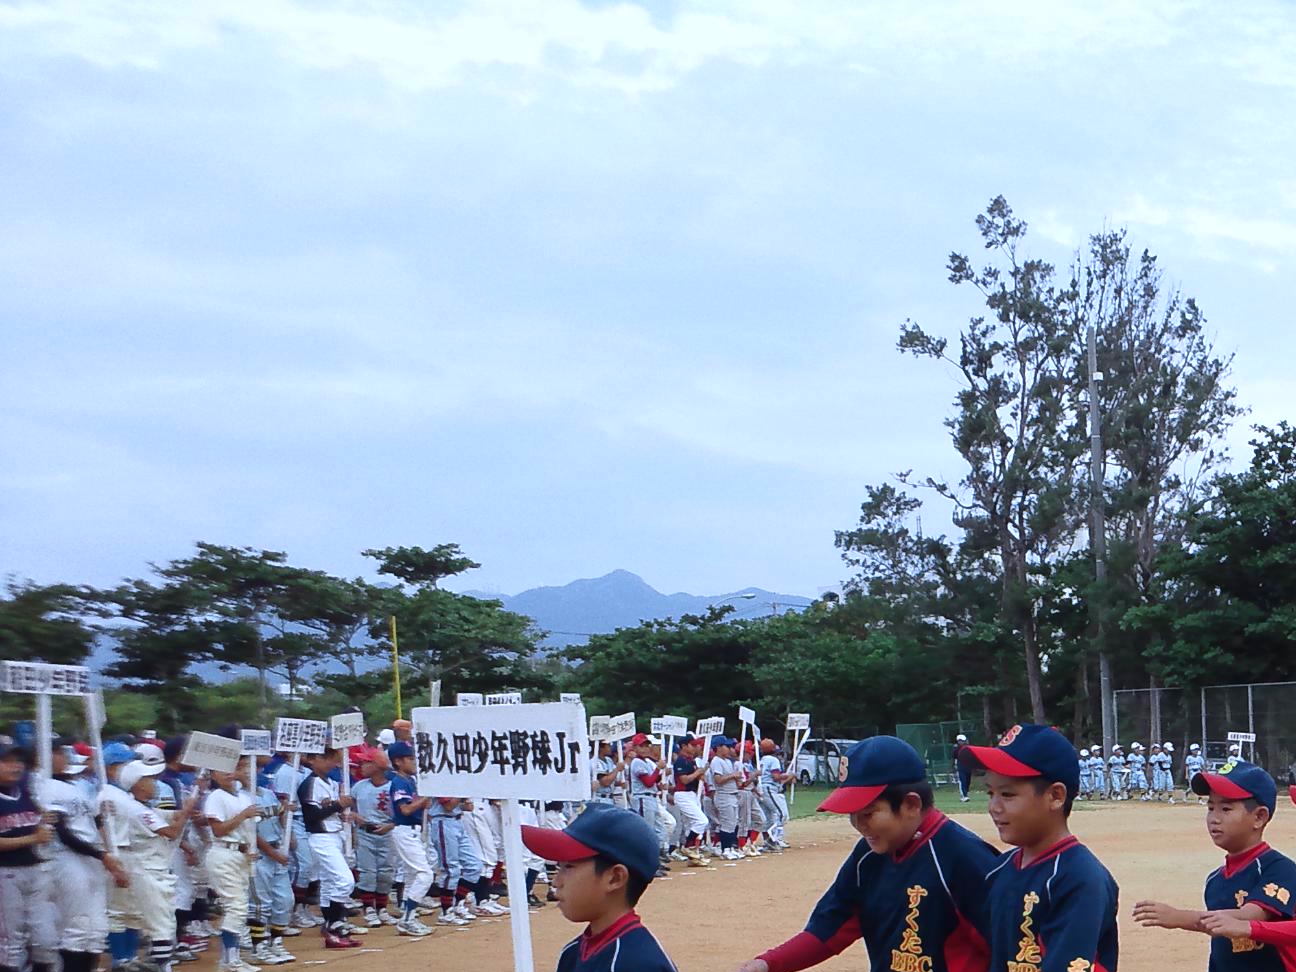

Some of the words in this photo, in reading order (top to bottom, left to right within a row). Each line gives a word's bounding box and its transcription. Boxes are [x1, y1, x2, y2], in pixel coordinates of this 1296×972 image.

[415, 728, 581, 776] 数久田少年野球Jr
[900, 884, 928, 954] すくた
[1016, 891, 1042, 964] すくた
